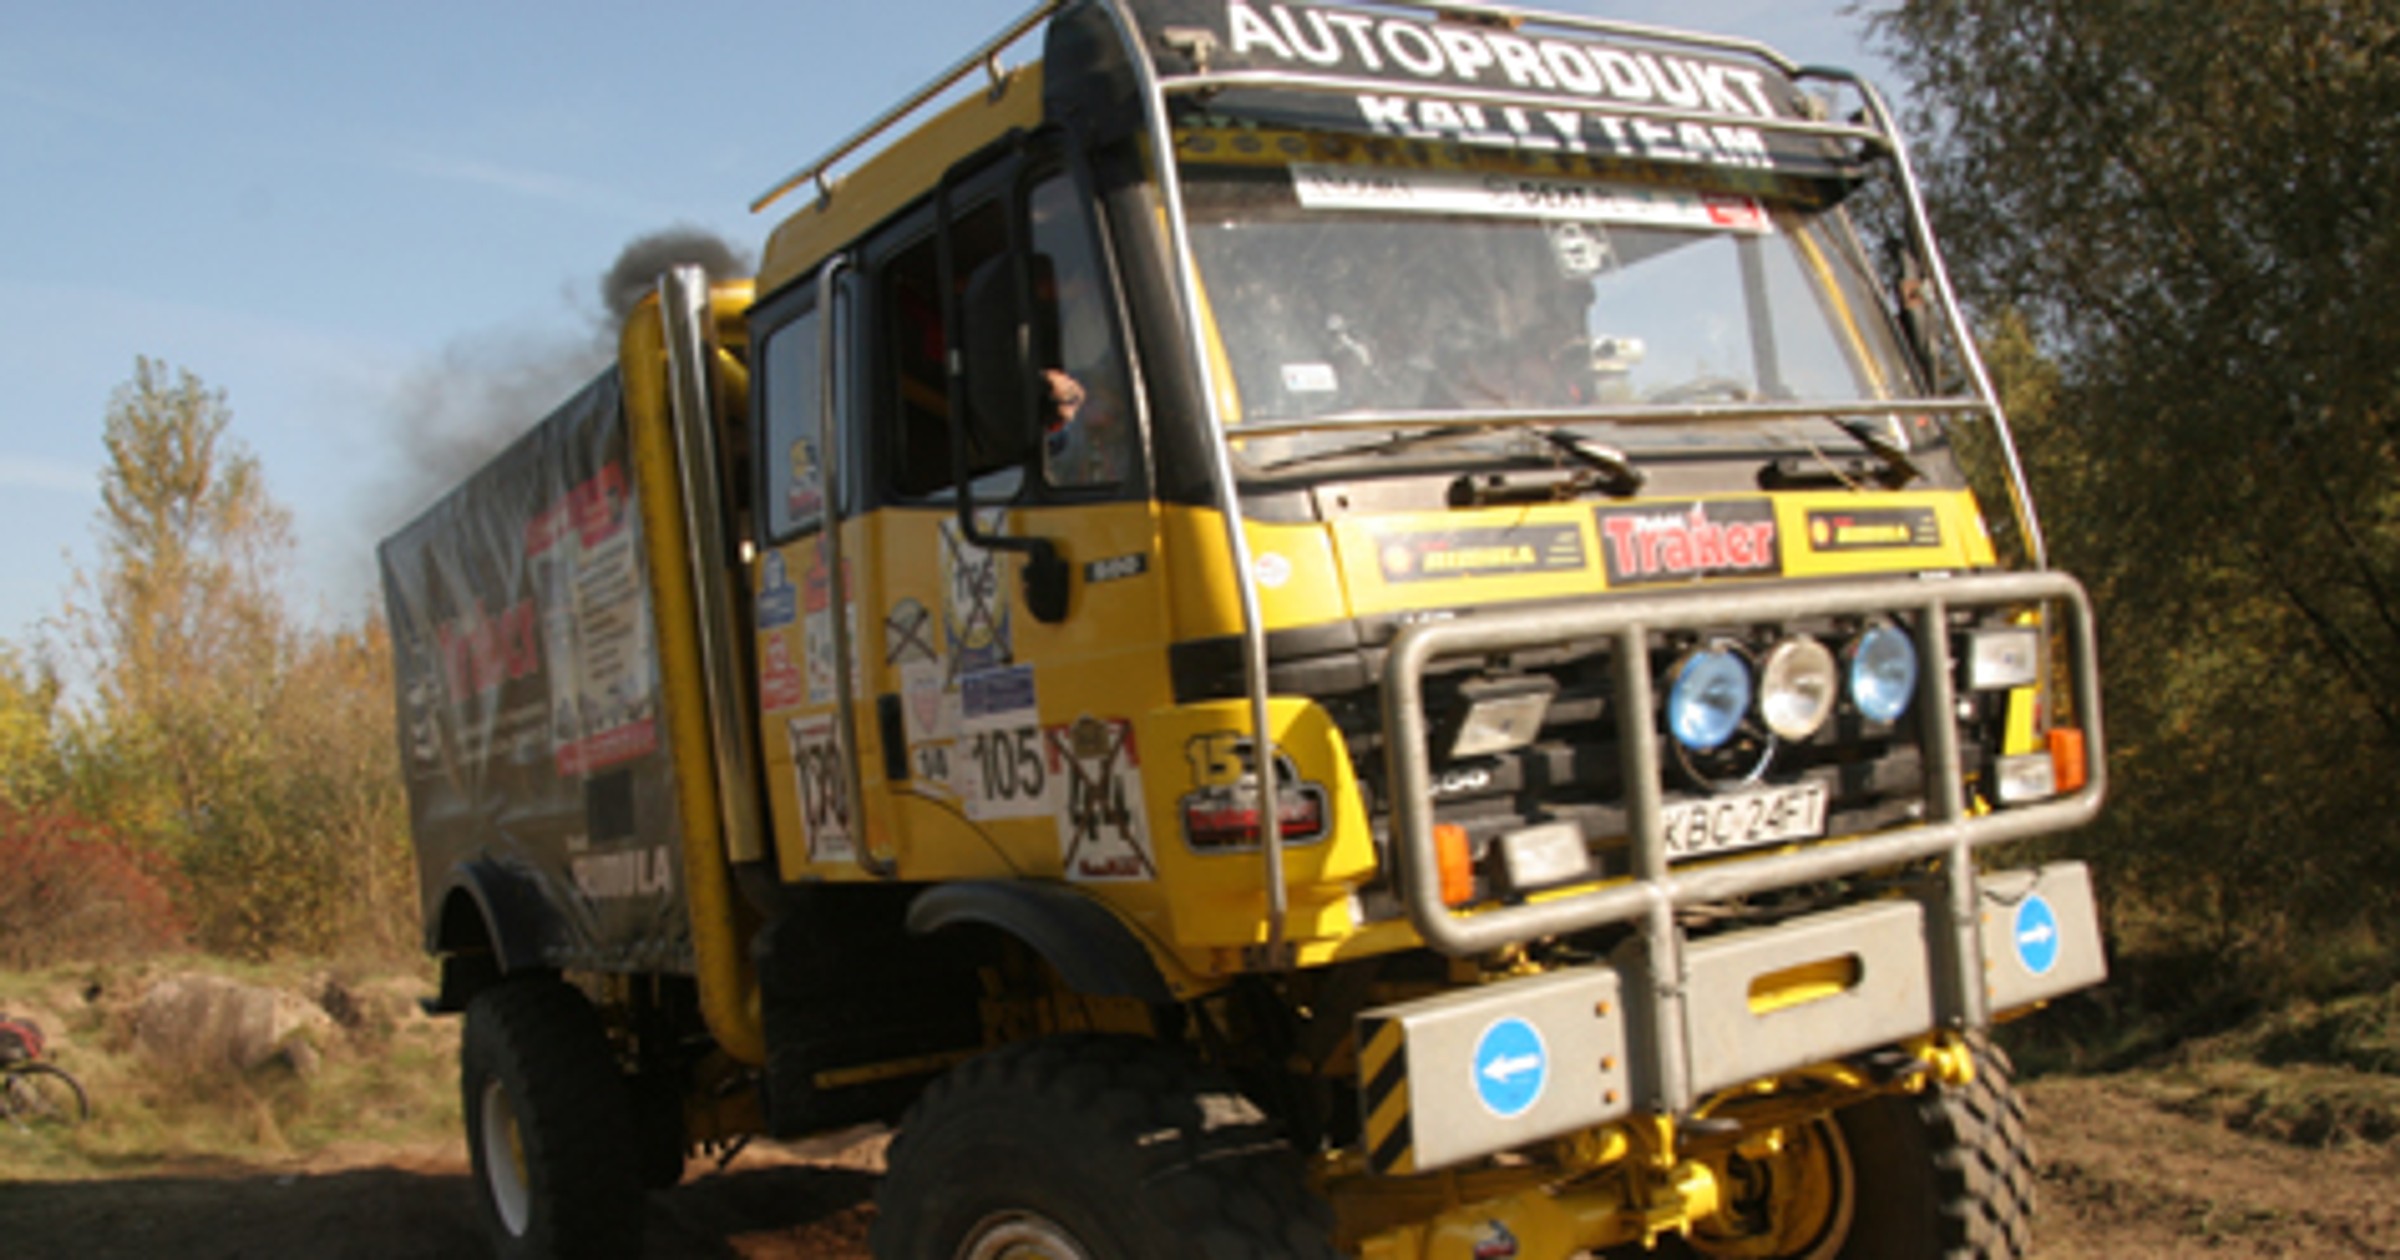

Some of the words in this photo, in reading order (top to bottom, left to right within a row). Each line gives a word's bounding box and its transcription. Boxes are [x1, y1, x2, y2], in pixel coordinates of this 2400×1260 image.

[1228, 0, 1776, 117] AUTOPRODUKT
[971, 726, 1045, 800] 105
[1186, 731, 1243, 788] 15
[1664, 802, 1734, 851] KBC
